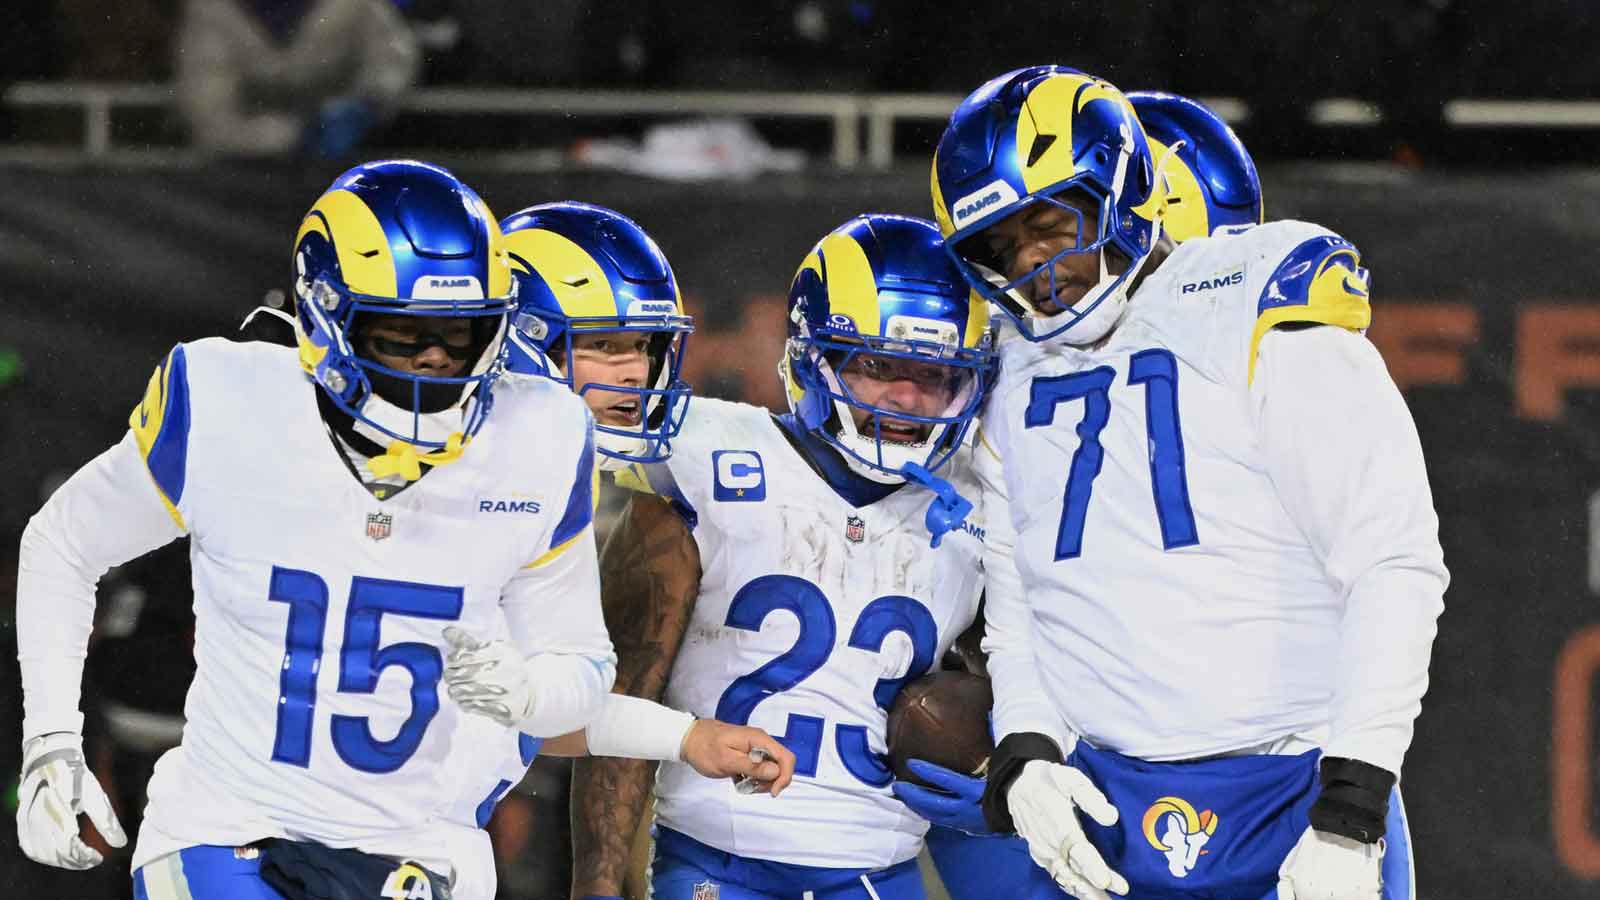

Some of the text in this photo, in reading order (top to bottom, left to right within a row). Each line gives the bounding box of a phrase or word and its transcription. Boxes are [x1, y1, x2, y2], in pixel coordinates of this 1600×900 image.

[956, 191, 1002, 220] RAMS
[430, 279, 471, 288] RAMS
[1182, 272, 1244, 294] RAMS
[718, 453, 762, 488] C
[1025, 348, 1200, 562] 71
[479, 500, 541, 514] RAMS
[268, 564, 465, 774] 15
[715, 574, 938, 789] 23
